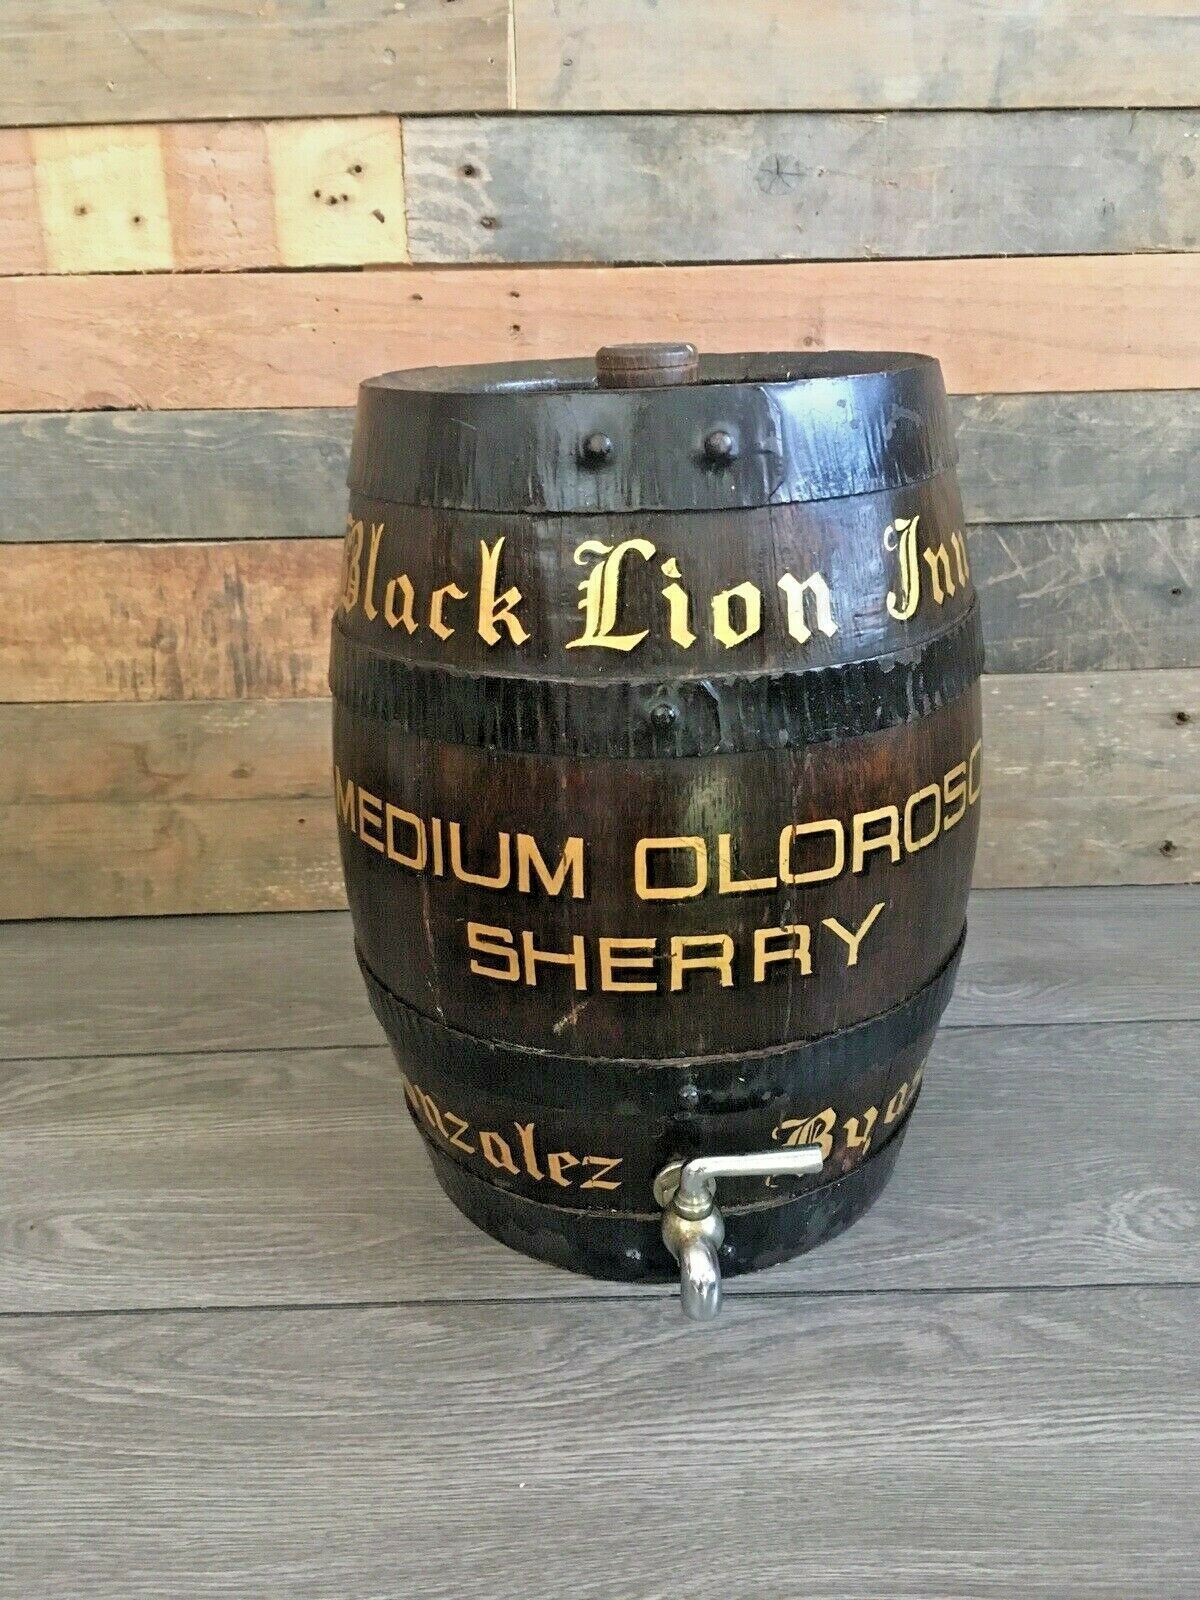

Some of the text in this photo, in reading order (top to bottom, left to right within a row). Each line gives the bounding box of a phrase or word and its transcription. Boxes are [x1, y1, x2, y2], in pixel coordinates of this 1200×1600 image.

[565, 538, 839, 652] Lion
[883, 515, 970, 620] Inn
[334, 765, 585, 899] MEDIUM
[467, 902, 886, 992] SHERRY
